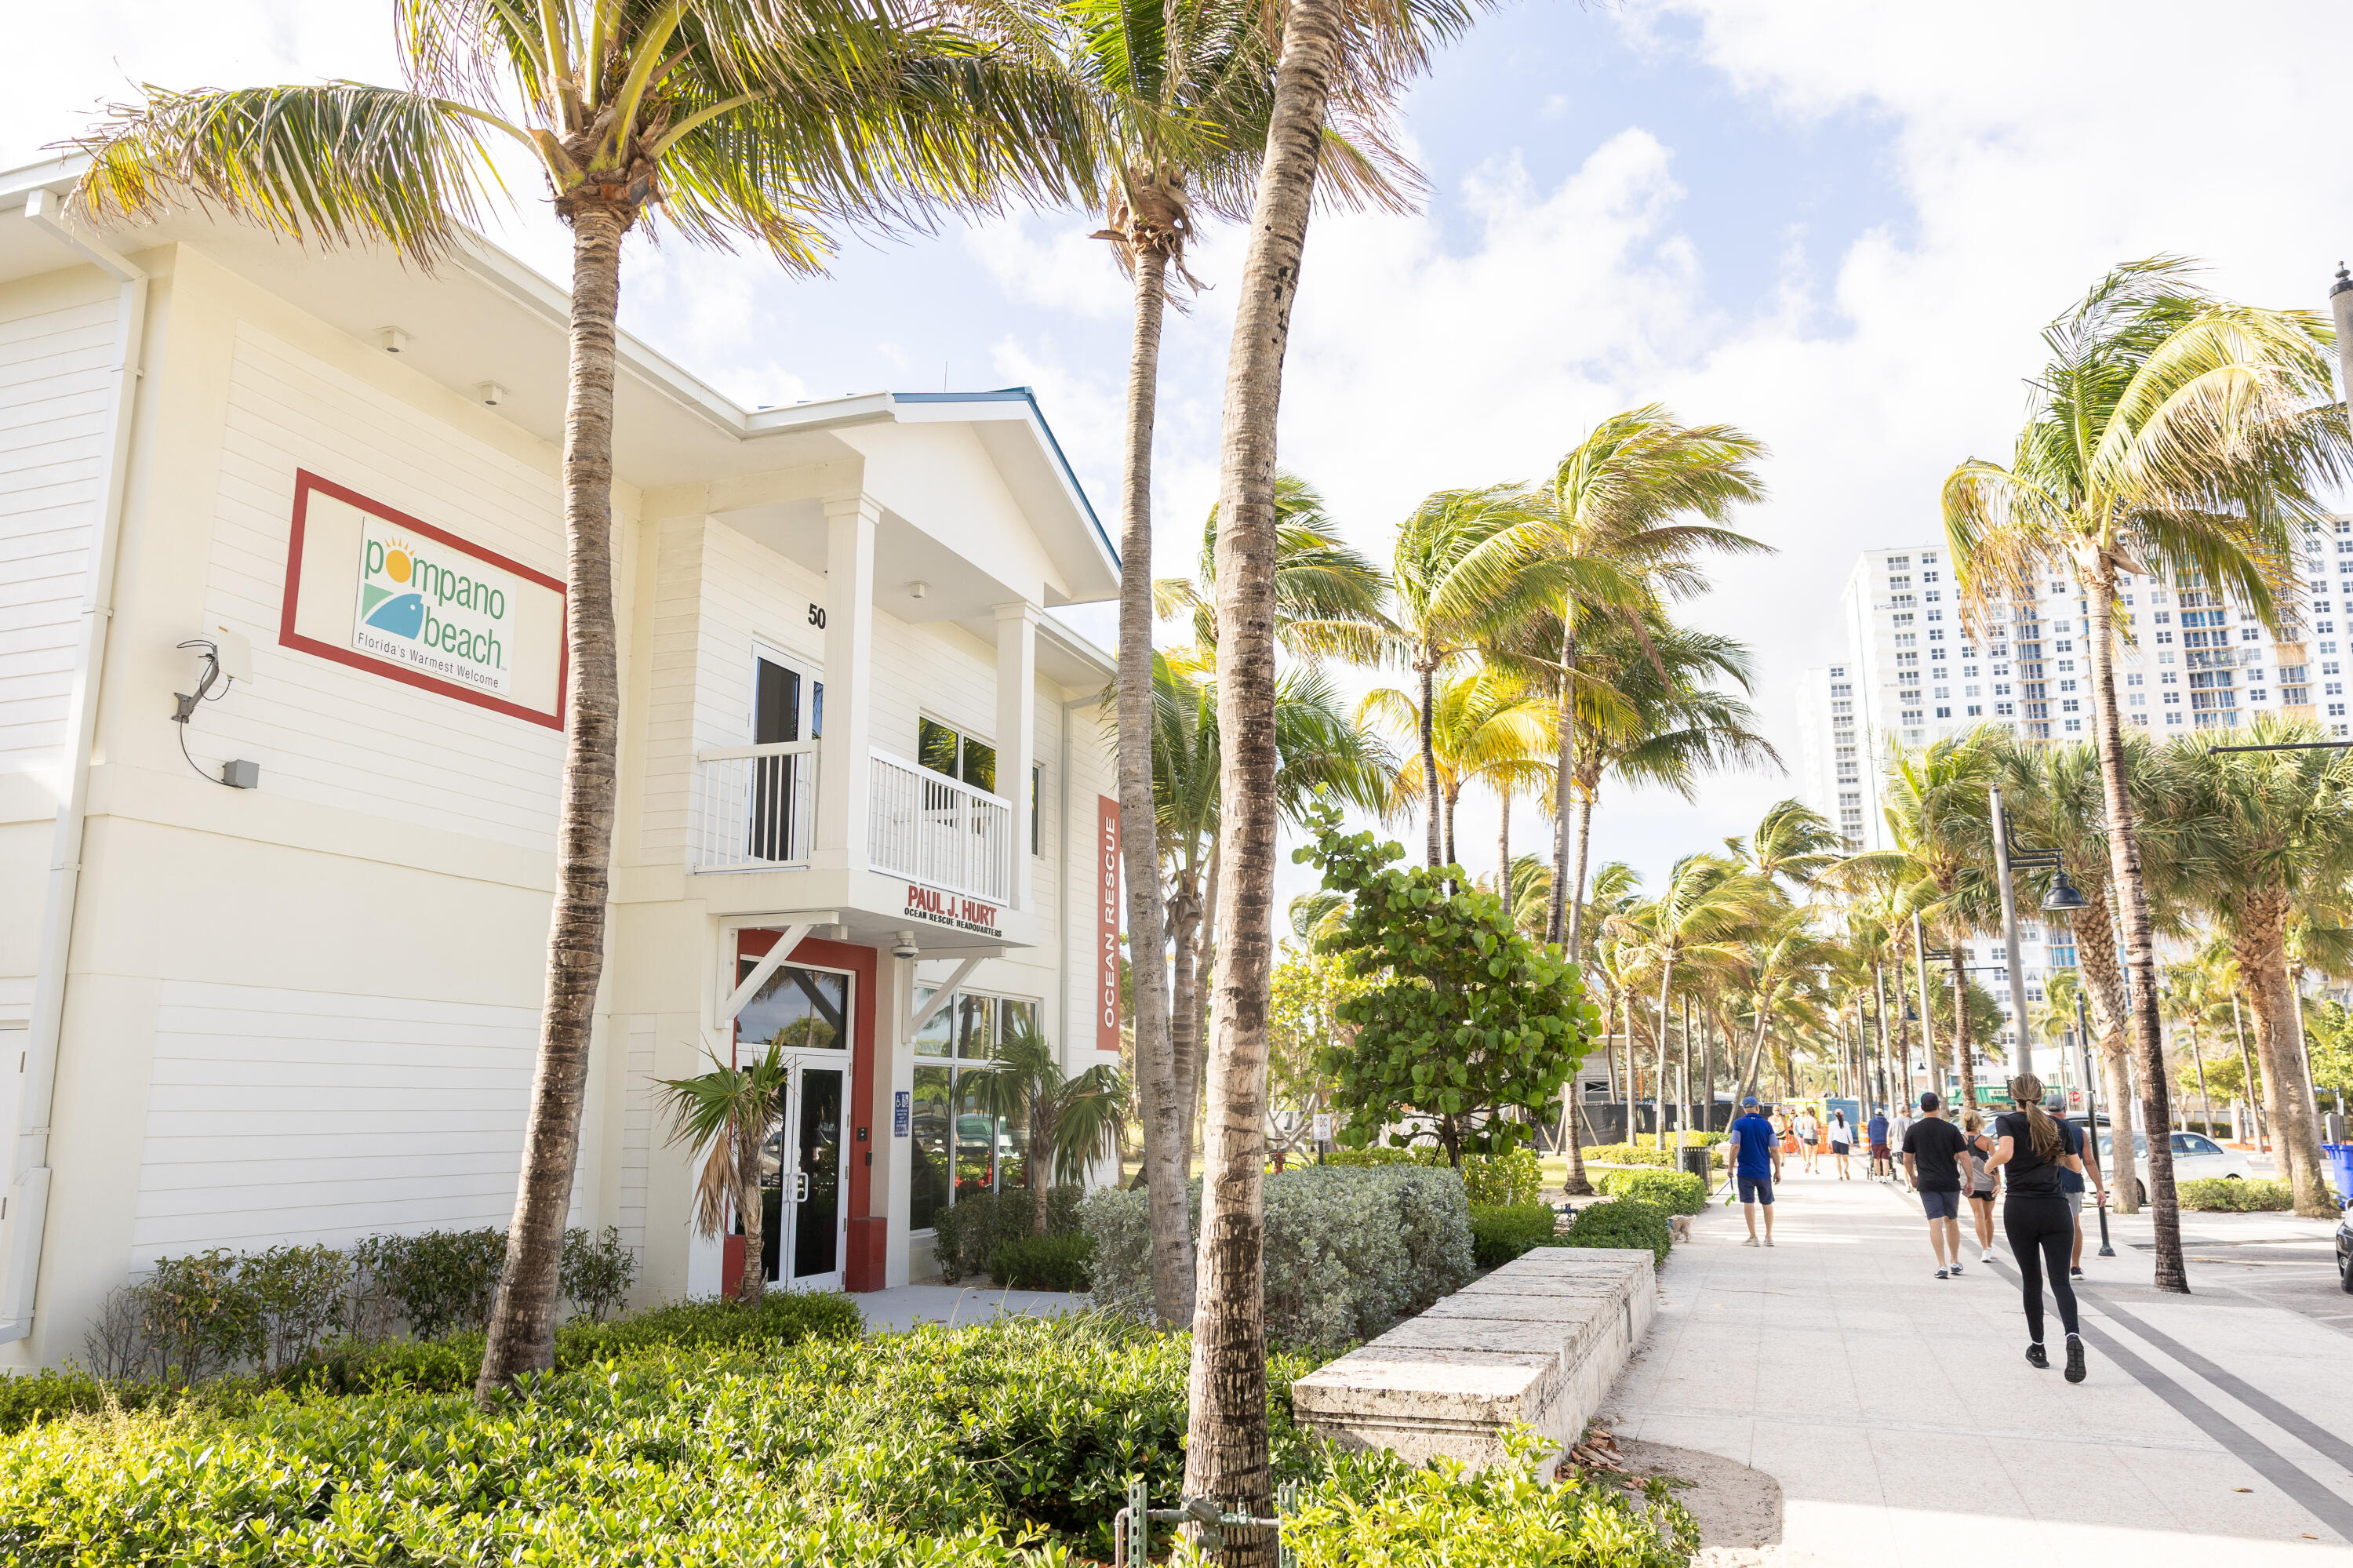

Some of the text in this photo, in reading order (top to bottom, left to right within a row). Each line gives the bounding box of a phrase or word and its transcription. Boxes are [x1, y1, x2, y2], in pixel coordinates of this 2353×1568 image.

[365, 539, 504, 620] pompano
[424, 606, 501, 668] beach
[808, 602, 826, 629] 50
[358, 632, 499, 688] Florida's Warmest Welcome
[904, 908, 1002, 937] OCEAN RESCUE HEADQUARTERS
[908, 885, 997, 927] PAUL J. HURT
[1104, 817, 1115, 1028] OCEAN RESCUE
